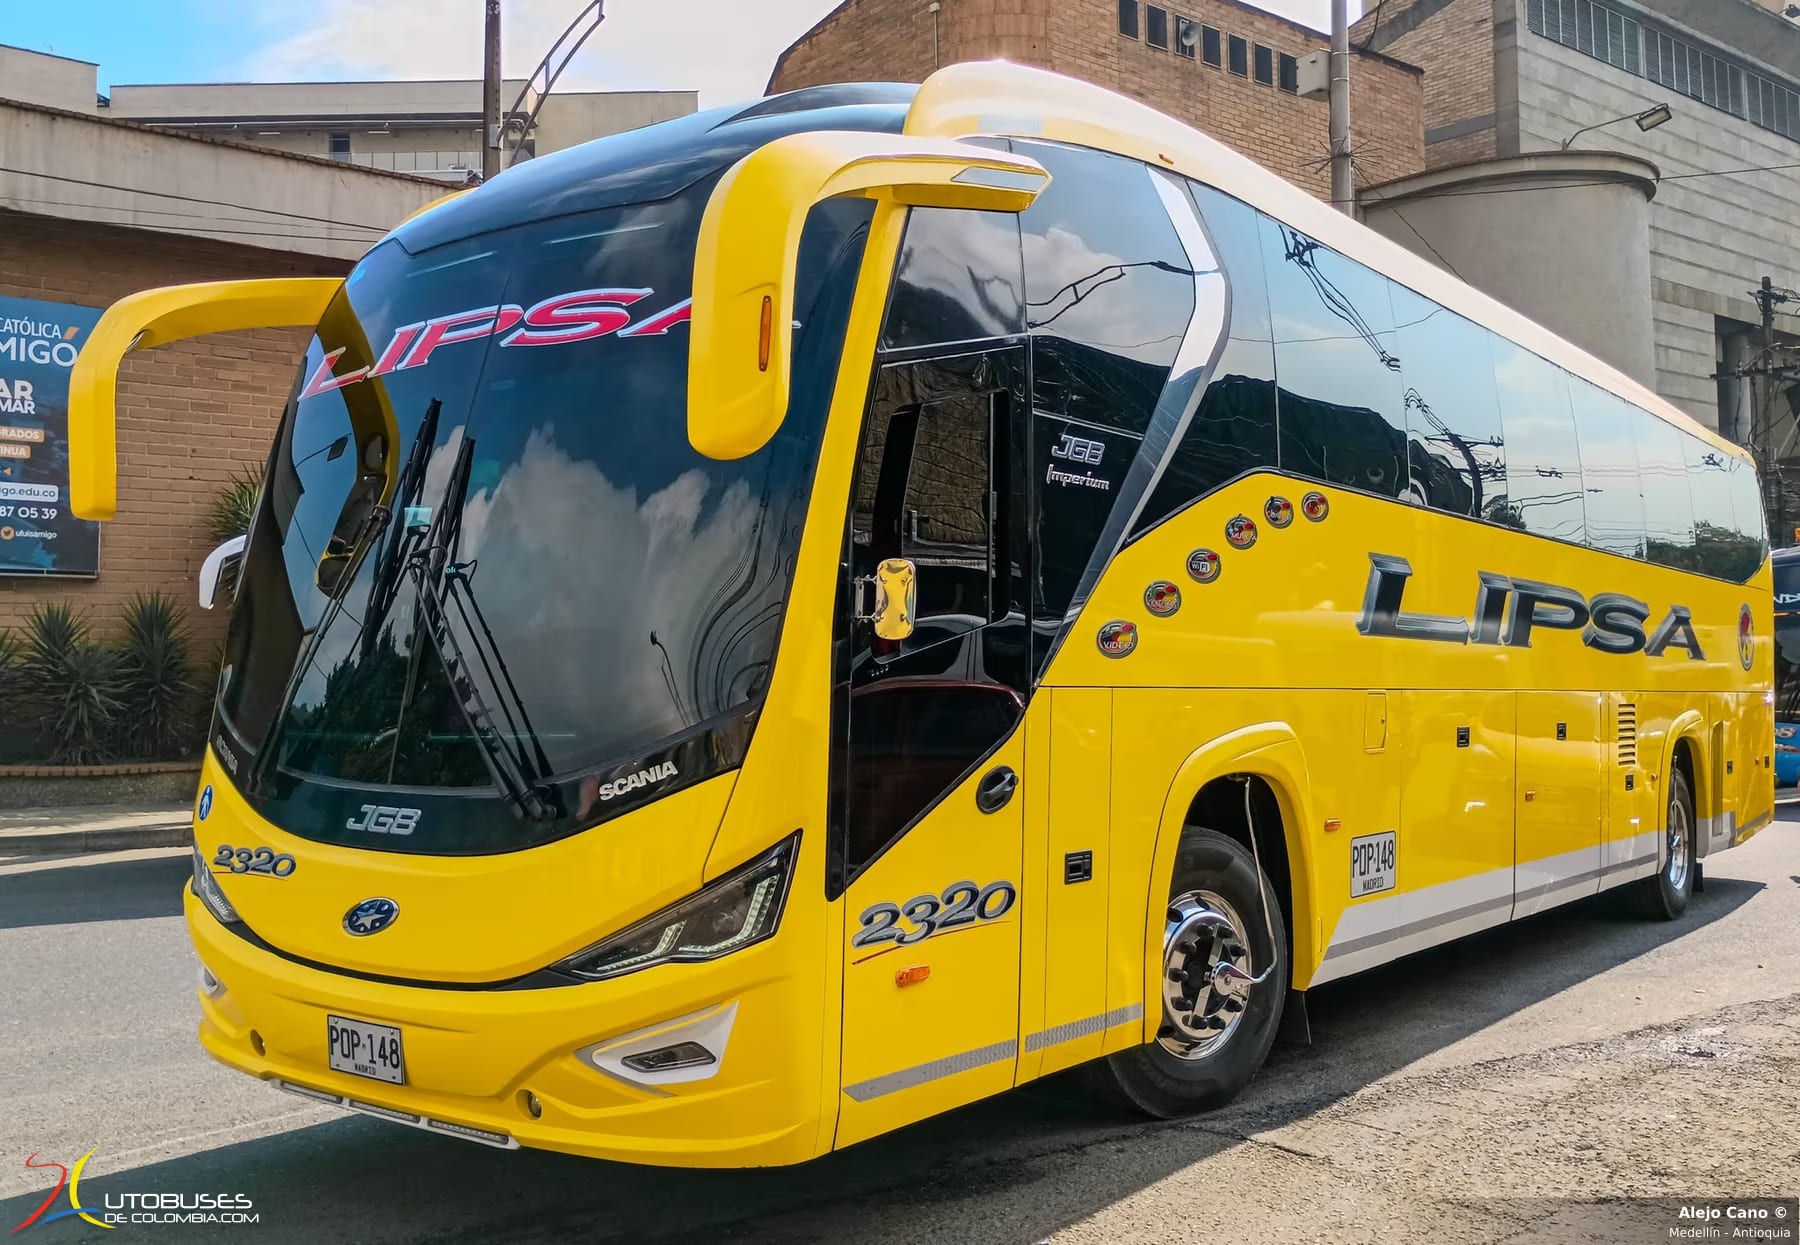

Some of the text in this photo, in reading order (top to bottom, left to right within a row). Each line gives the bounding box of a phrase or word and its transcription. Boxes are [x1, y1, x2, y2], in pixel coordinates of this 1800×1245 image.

[0, 378, 34, 401] AR
[0, 398, 36, 415] MAR
[0, 428, 40, 440] RADOS
[1051, 434, 1106, 466] JGB
[1046, 464, 1110, 490] Imperium
[0, 487, 56, 497] go.edu.co
[0, 505, 15, 517] 87
[41, 507, 58, 520] 39
[1356, 552, 1707, 661] LIPSA
[599, 761, 679, 801] SCANIA
[346, 805, 423, 836] JGB
[213, 844, 297, 878] 2320
[1362, 876, 1384, 892] MADRID
[851, 880, 1017, 949] 2320
[354, 1063, 377, 1076] MADRID
